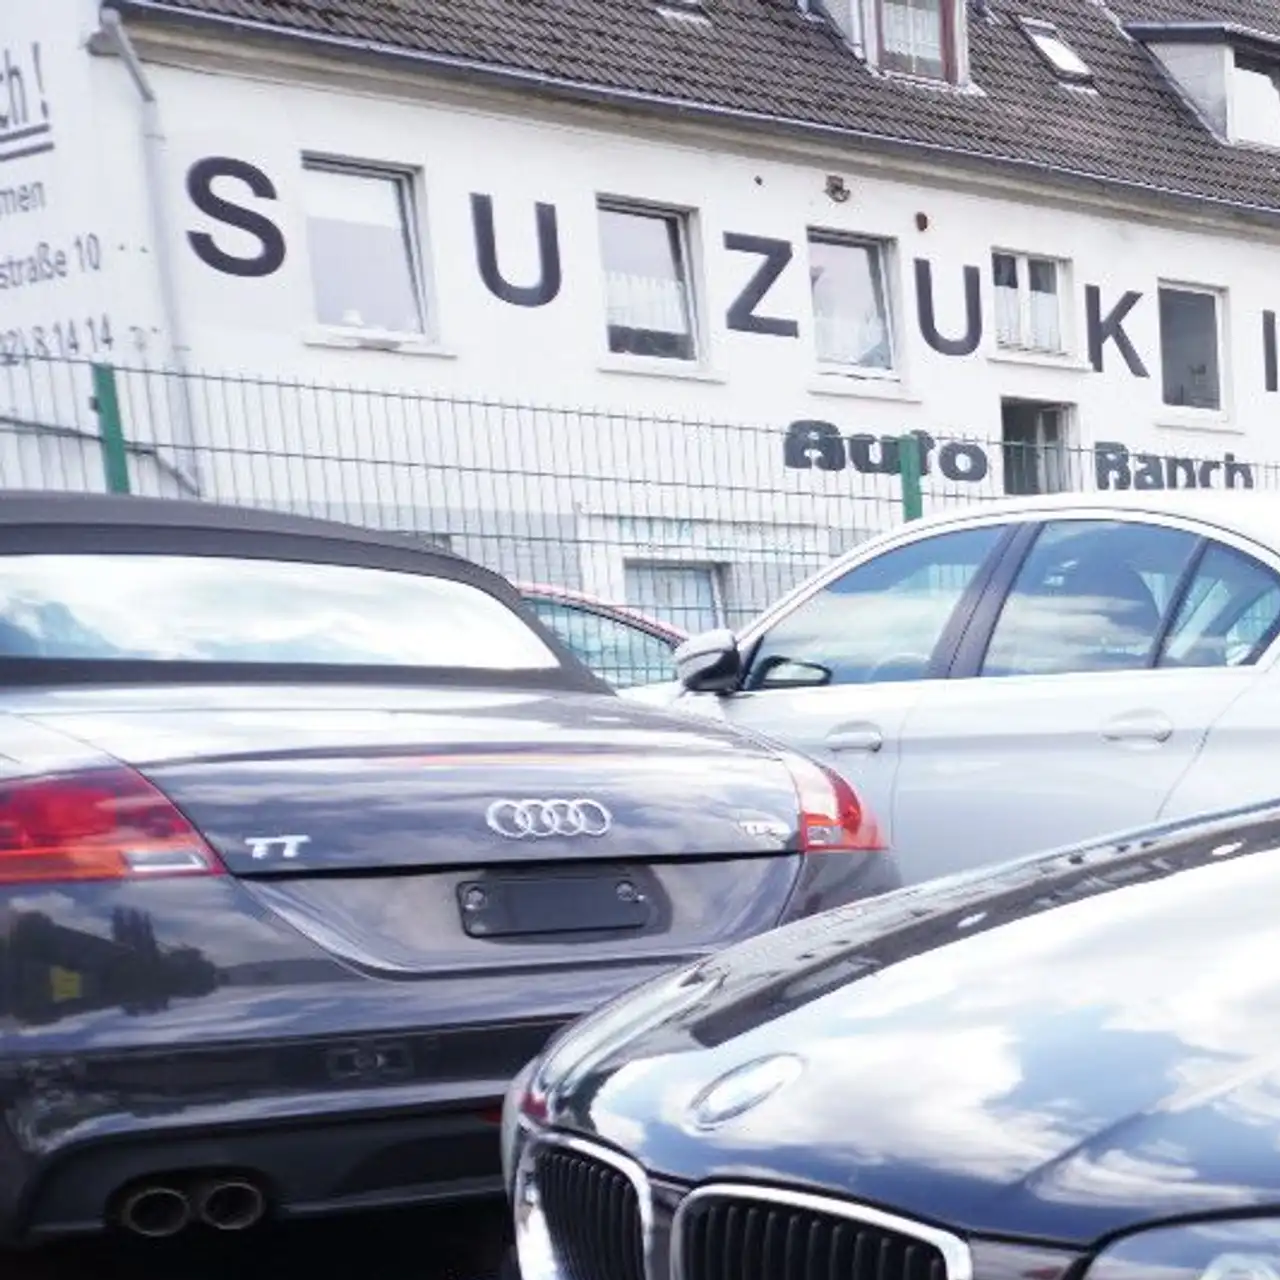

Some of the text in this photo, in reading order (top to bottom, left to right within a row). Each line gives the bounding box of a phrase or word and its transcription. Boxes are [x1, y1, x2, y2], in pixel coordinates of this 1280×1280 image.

[74, 232, 100, 272] 10
[85, 312, 114, 353] 14
[1095, 440, 1254, 491] Ranch
[244, 834, 312, 859] TT
